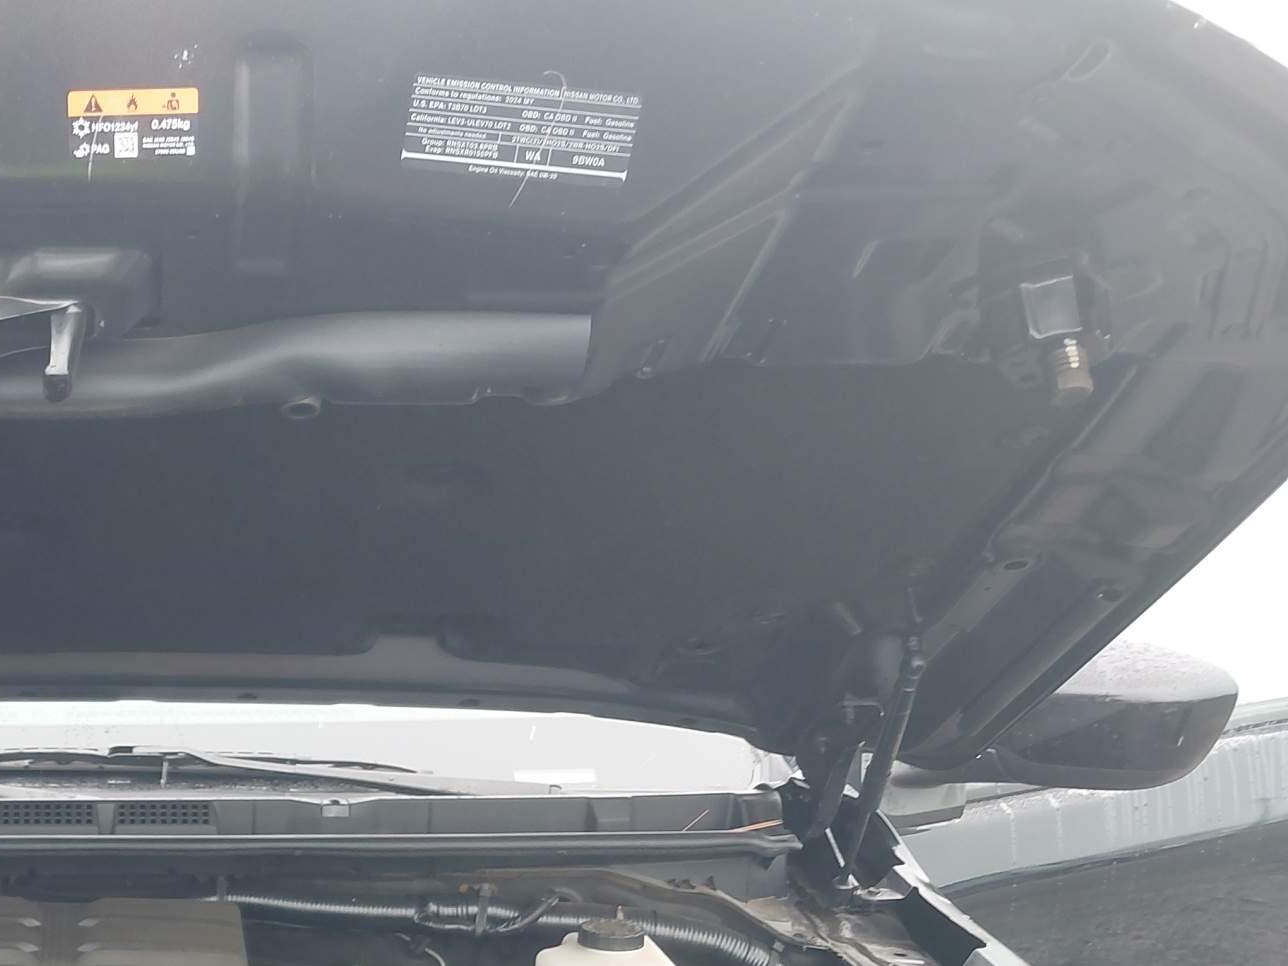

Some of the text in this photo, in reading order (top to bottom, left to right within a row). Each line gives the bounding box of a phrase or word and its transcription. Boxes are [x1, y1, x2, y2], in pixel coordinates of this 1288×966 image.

[417, 76, 560, 98] VEHICLE EMISSION CONTROL INFORMATION
[415, 86, 449, 98] Conforms
[459, 91, 502, 102] regulations:
[564, 89, 588, 99] NISSAN
[589, 92, 611, 101] MOTOR
[413, 99, 427, 108] U.S.
[411, 113, 446, 123] California:
[605, 118, 634, 128] Gasoline
[603, 132, 632, 142] Gasoline
[525, 151, 541, 161] WA
